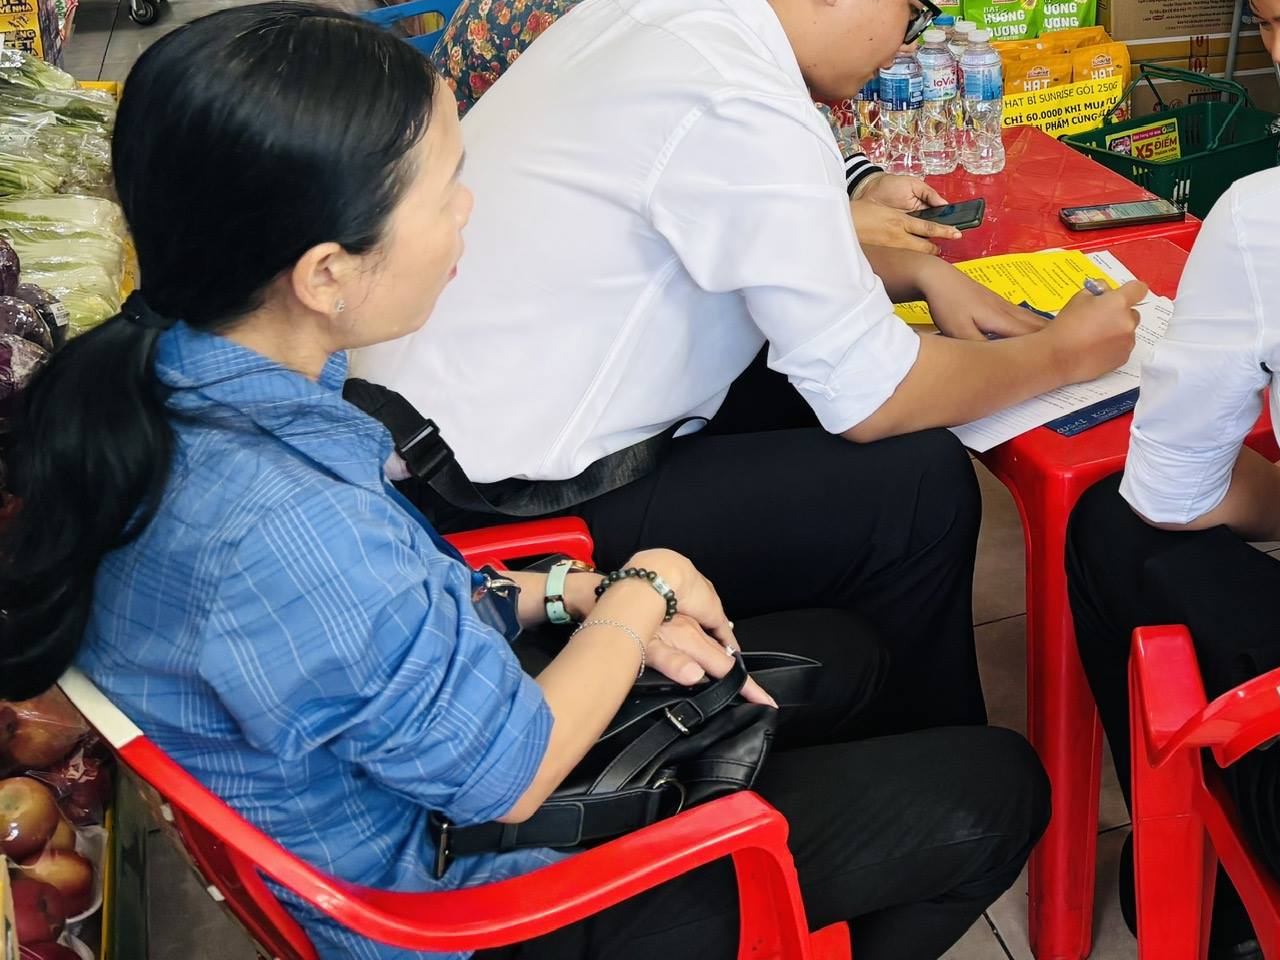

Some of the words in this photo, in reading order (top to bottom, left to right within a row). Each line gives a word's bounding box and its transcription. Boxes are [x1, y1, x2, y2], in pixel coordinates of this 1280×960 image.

[1040, 88, 1074, 103] SUNRISE
[1065, 103, 1081, 115] KHI
[1135, 142, 1154, 160] X5
